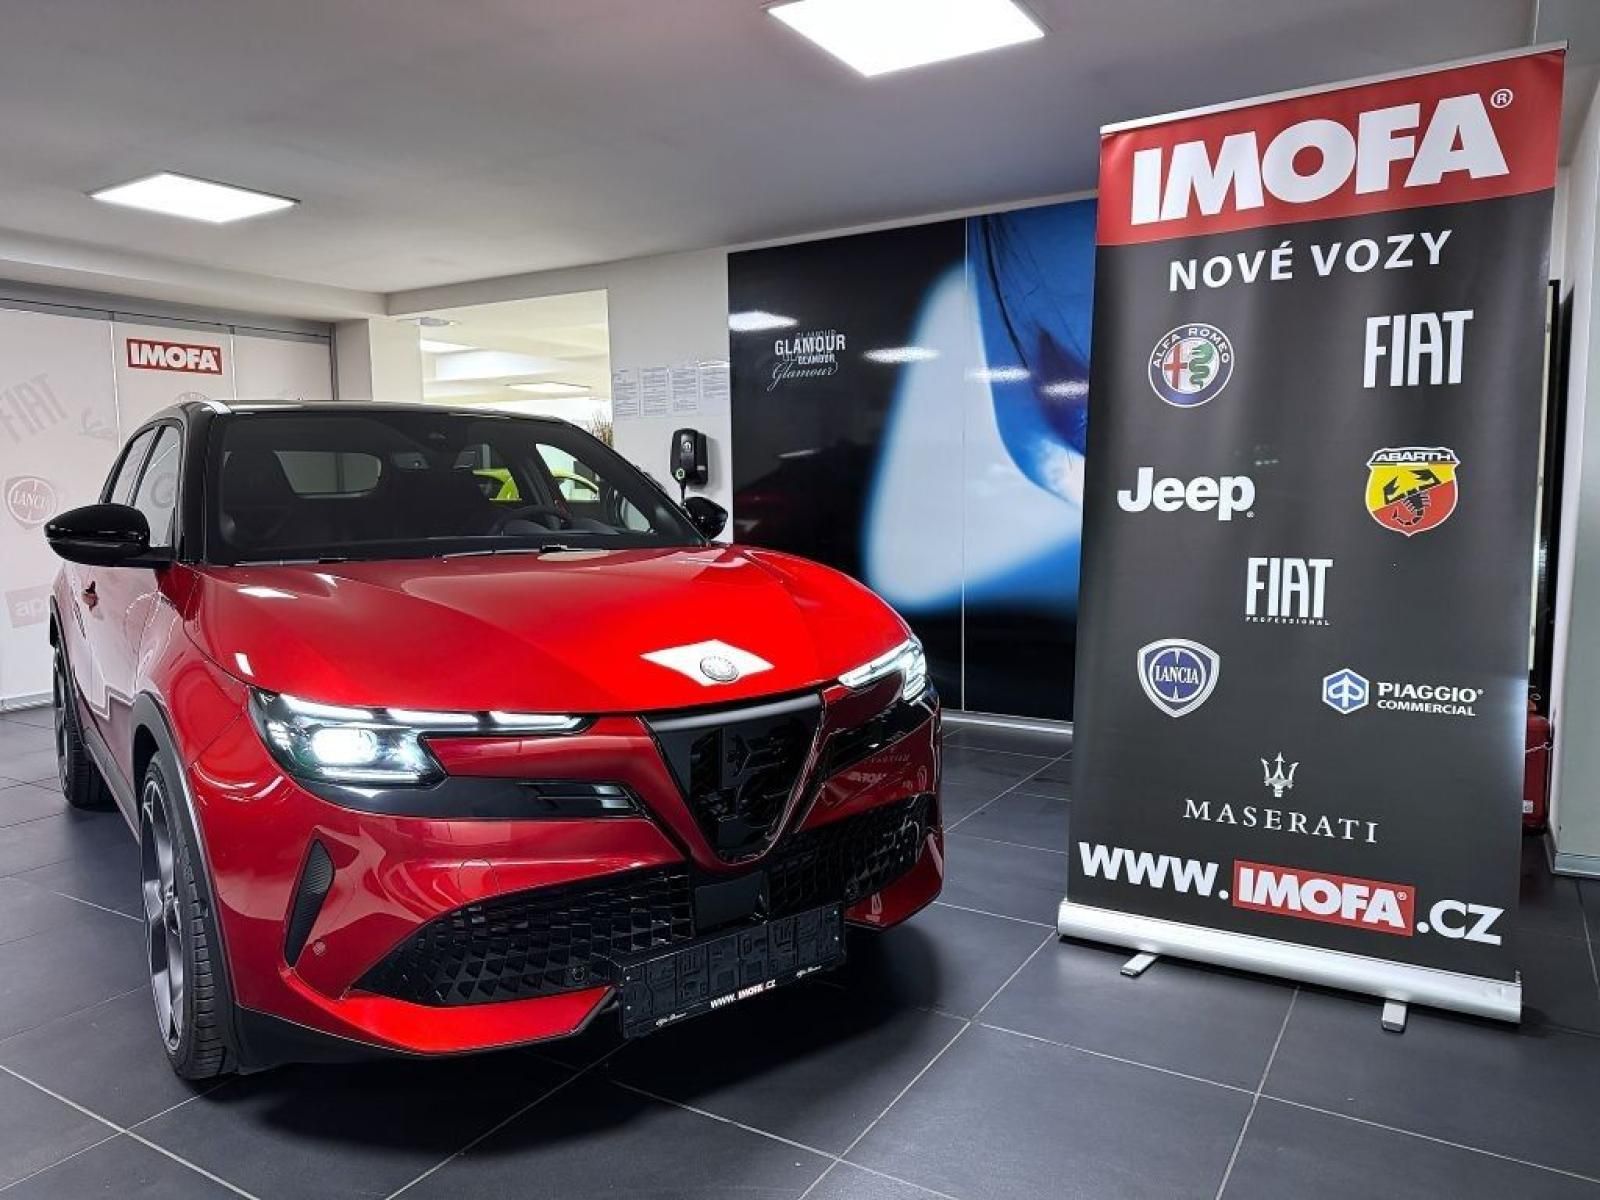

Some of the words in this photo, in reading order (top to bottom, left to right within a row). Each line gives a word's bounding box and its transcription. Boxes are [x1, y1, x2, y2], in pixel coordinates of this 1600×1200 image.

[1131, 93, 1510, 226] IMOFA
[1169, 241, 1294, 292] NOVÉ
[1311, 229, 1454, 277] VOZY
[130, 342, 219, 372] IMOFA
[774, 333, 846, 356] GLAMOUR
[1152, 333, 1182, 368] ALFA
[1188, 327, 1231, 364] ROMEO
[1363, 309, 1474, 389] FIAT
[1375, 449, 1452, 464] ABARTH
[1116, 466, 1256, 521] Jeep
[1245, 556, 1335, 619] FIAT
[1153, 665, 1200, 686] LANCIA
[1376, 682, 1478, 704] PIAGGIO
[1376, 699, 1477, 717] COMMERCIAL
[1182, 798, 1380, 844] MASERATI
